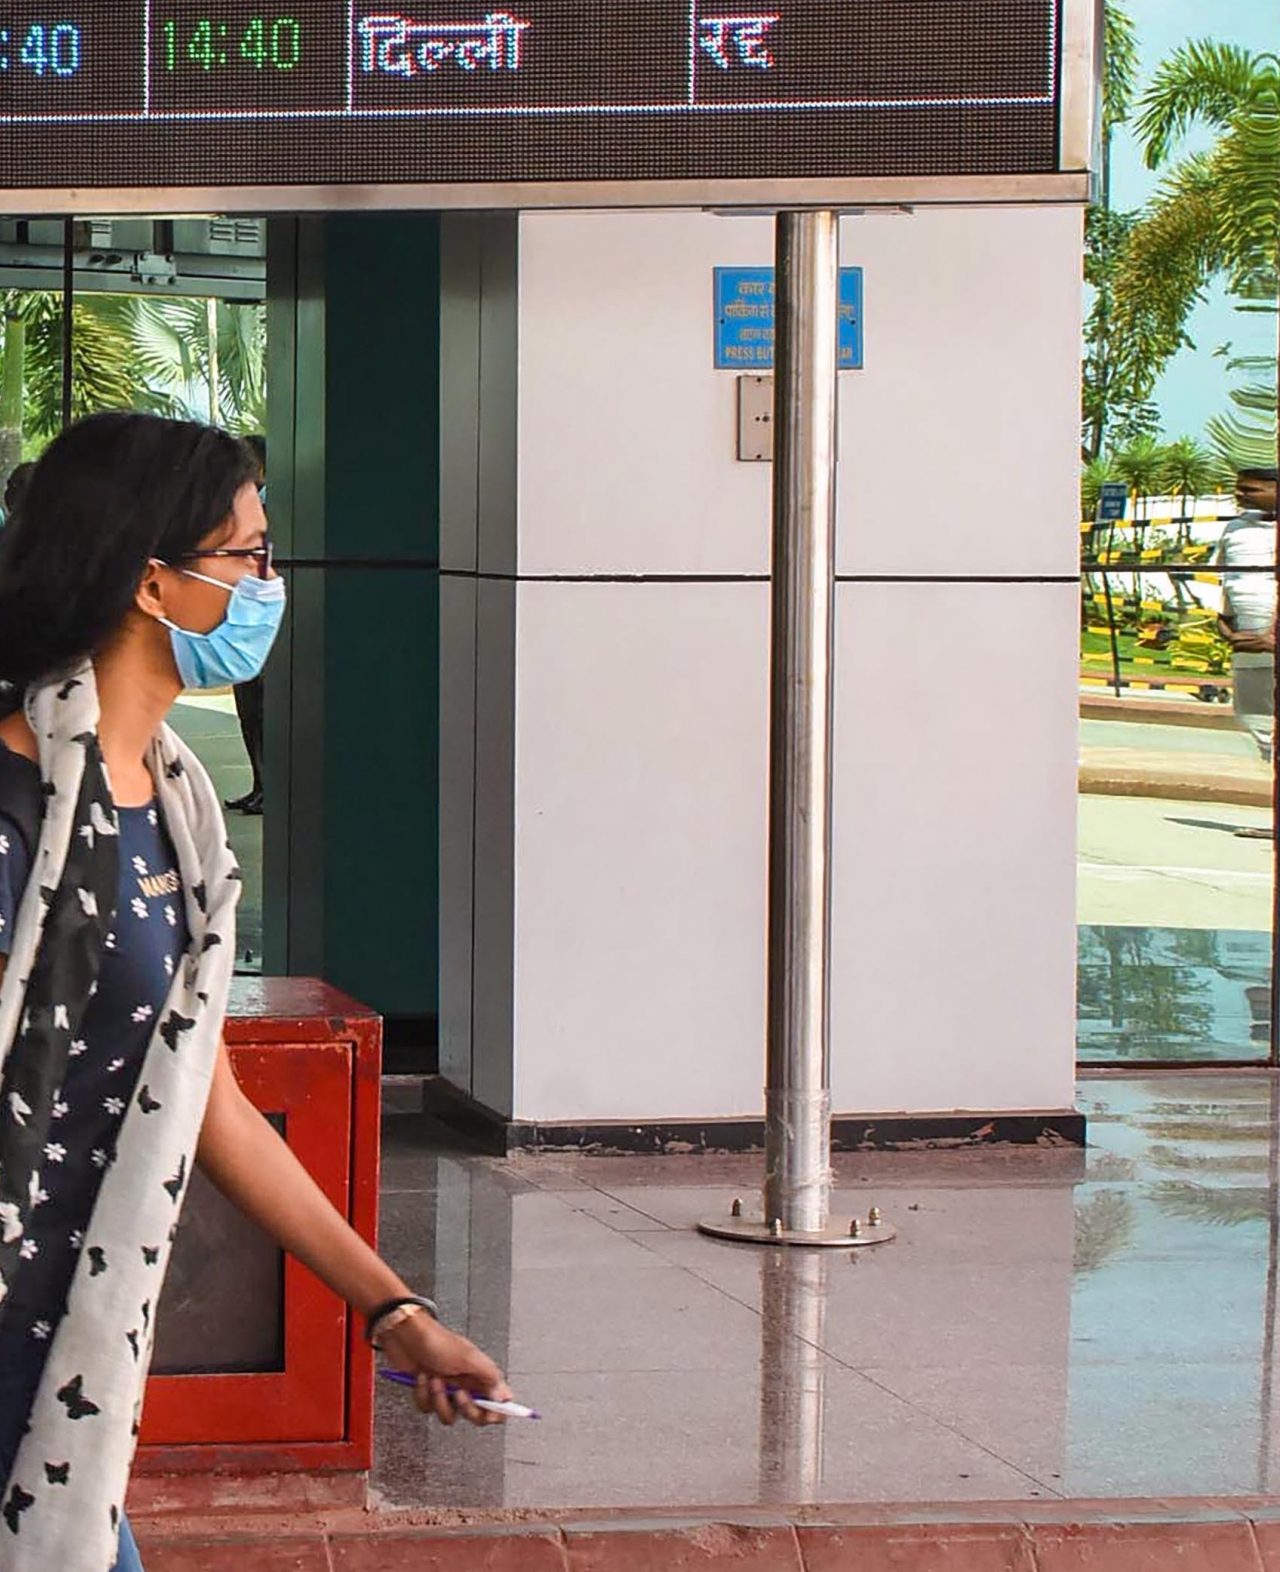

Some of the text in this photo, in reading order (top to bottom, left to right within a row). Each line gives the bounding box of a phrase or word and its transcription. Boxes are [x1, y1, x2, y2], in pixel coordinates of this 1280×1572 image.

[163, 18, 300, 71] 14:40
[357, 12, 532, 77] दिल्ली
[726, 346, 753, 360] PRESS
